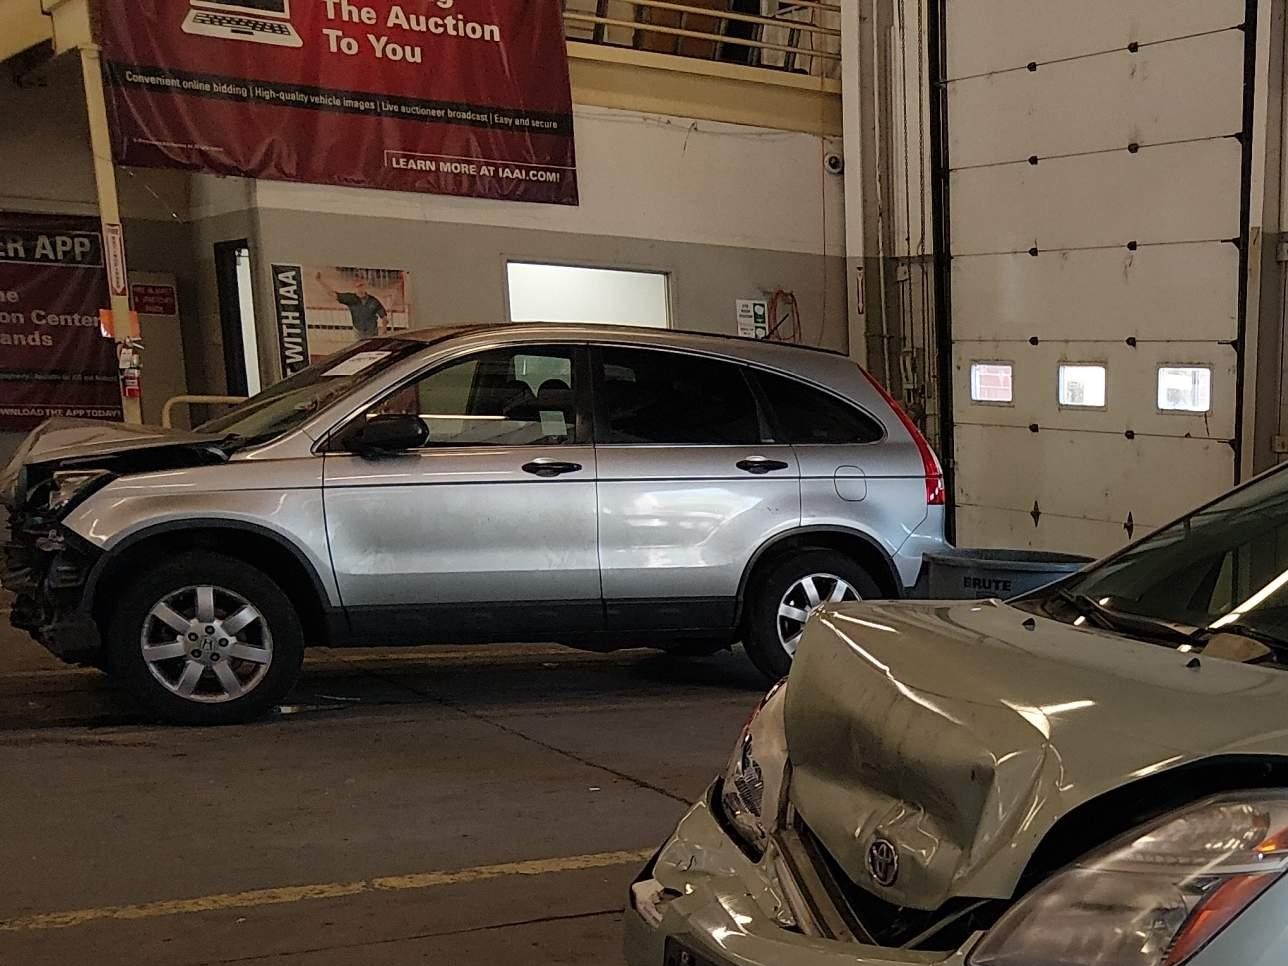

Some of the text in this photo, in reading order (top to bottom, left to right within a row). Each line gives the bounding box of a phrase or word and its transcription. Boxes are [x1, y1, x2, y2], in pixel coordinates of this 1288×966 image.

[322, 0, 501, 42] The Auction
[323, 29, 422, 63] To You
[125, 70, 180, 88] Convenient
[182, 79, 211, 92] online
[213, 83, 247, 97] bidding
[255, 89, 308, 104] High-quality
[310, 94, 341, 106] vehicle
[343, 97, 375, 110] images
[381, 101, 399, 112] Live
[401, 104, 445, 117] auctioneer
[447, 109, 488, 122] broadcast
[494, 114, 513, 127] Easy
[514, 116, 529, 127] and
[531, 119, 558, 129] secure
[392, 157, 560, 183] LEARN MORE AT IAAI.COM!
[35, 235, 91, 260] APP
[278, 270, 299, 305] IAA
[279, 312, 305, 364] WITH
[45, 408, 63, 417] THE
[66, 408, 85, 417] APP
[963, 576, 1012, 591] BRUTE
